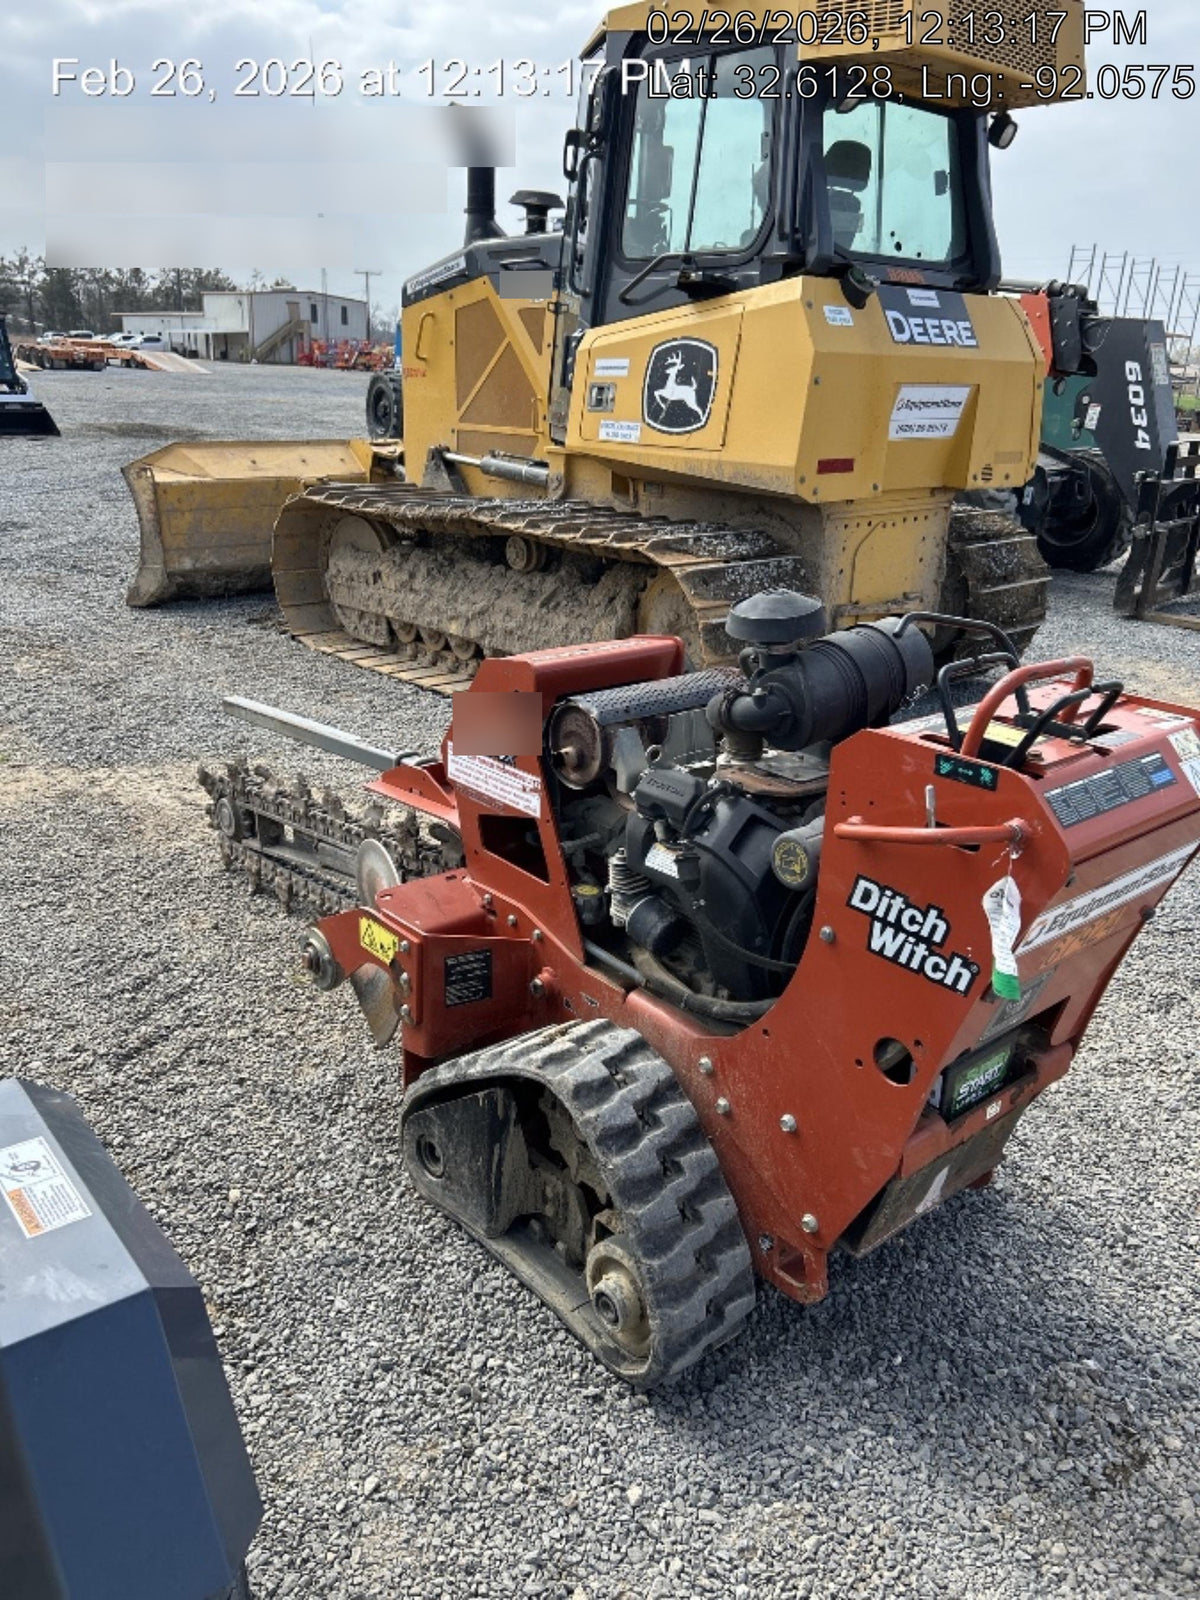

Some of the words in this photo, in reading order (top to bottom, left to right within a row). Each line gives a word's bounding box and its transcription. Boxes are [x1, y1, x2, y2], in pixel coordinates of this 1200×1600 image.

[885, 309, 977, 346] DEERE
[1125, 360, 1152, 450] 6034
[850, 878, 948, 943] Ditch
[870, 920, 973, 992] Witch
